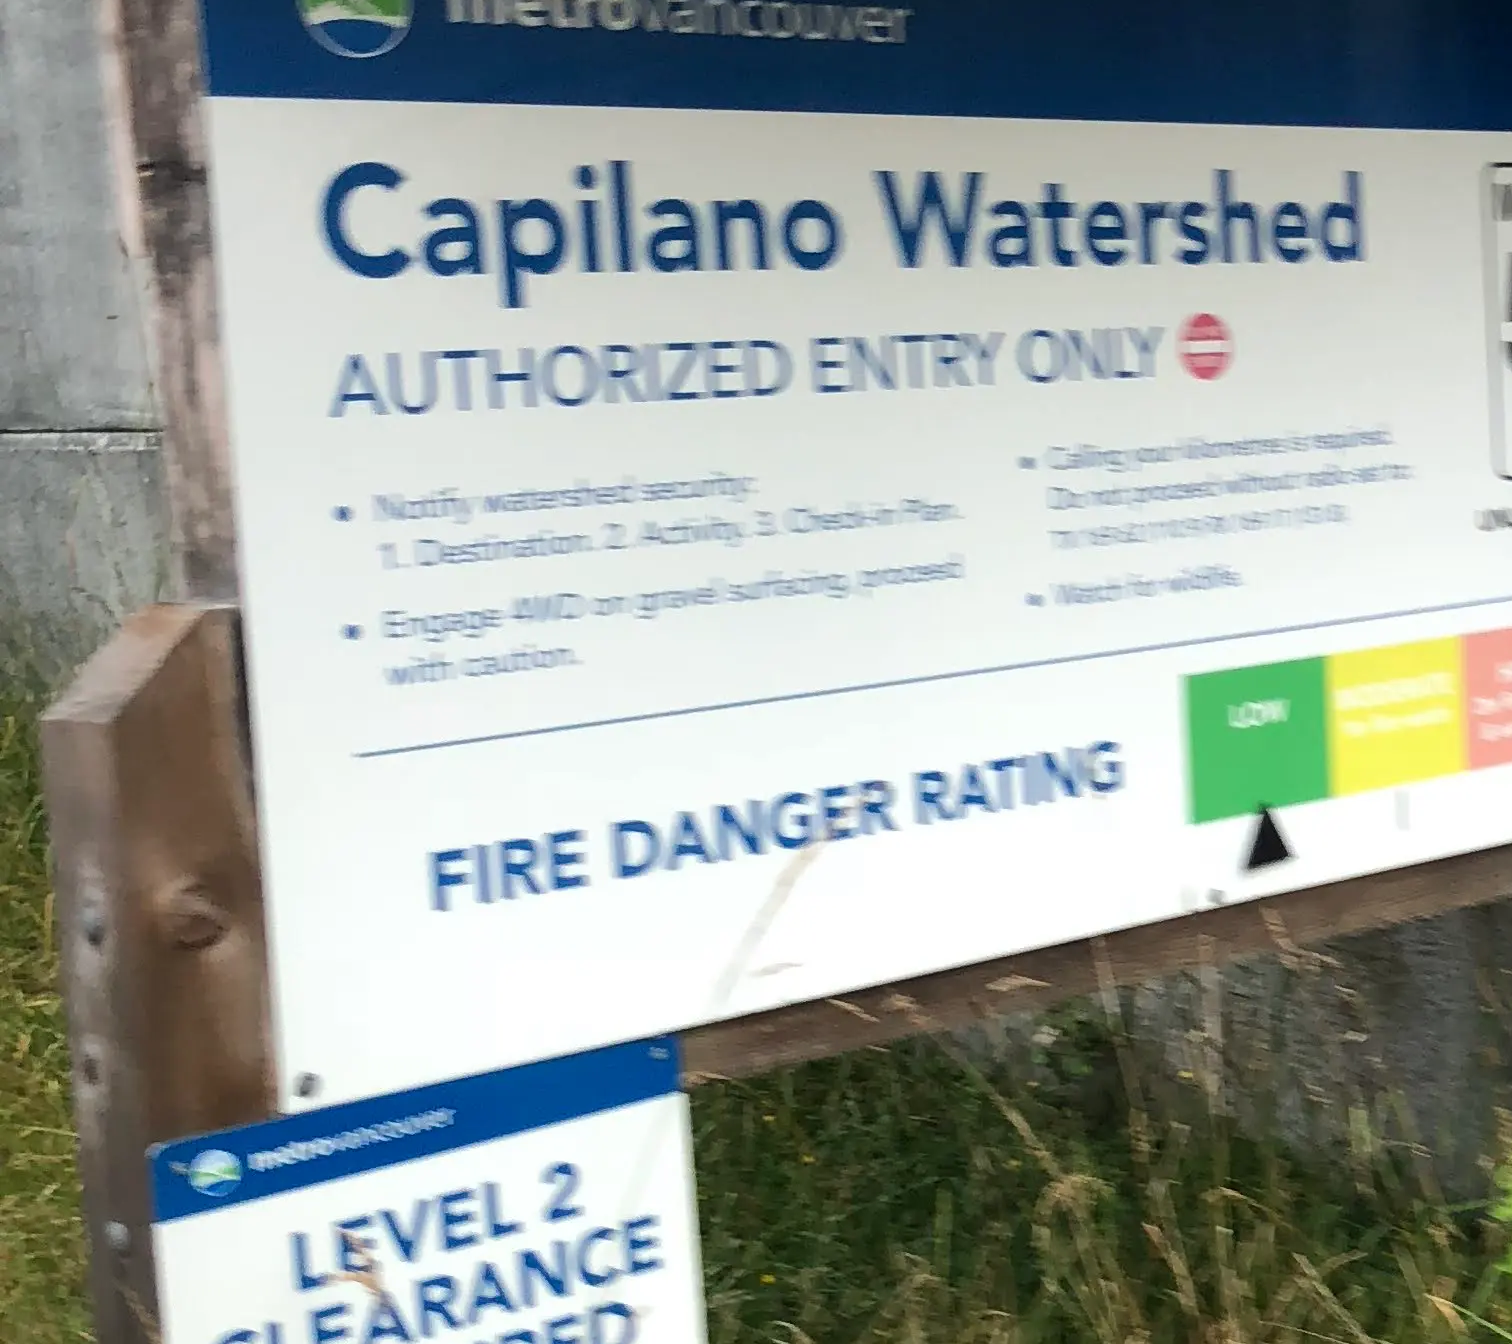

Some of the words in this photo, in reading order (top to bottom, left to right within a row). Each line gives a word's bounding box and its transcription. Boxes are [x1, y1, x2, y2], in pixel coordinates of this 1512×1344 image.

[322, 160, 843, 307] Capilano
[873, 169, 1367, 268] Watershed
[327, 337, 796, 419] AUTHORIZED
[808, 330, 1006, 395] ENTRY
[1016, 325, 1164, 384] ONLY
[425, 827, 590, 912] FIRE
[606, 775, 897, 883] DANGER
[916, 737, 1126, 826] RATING
[289, 1181, 524, 1293] LEVEL
[540, 1160, 586, 1226] 2
